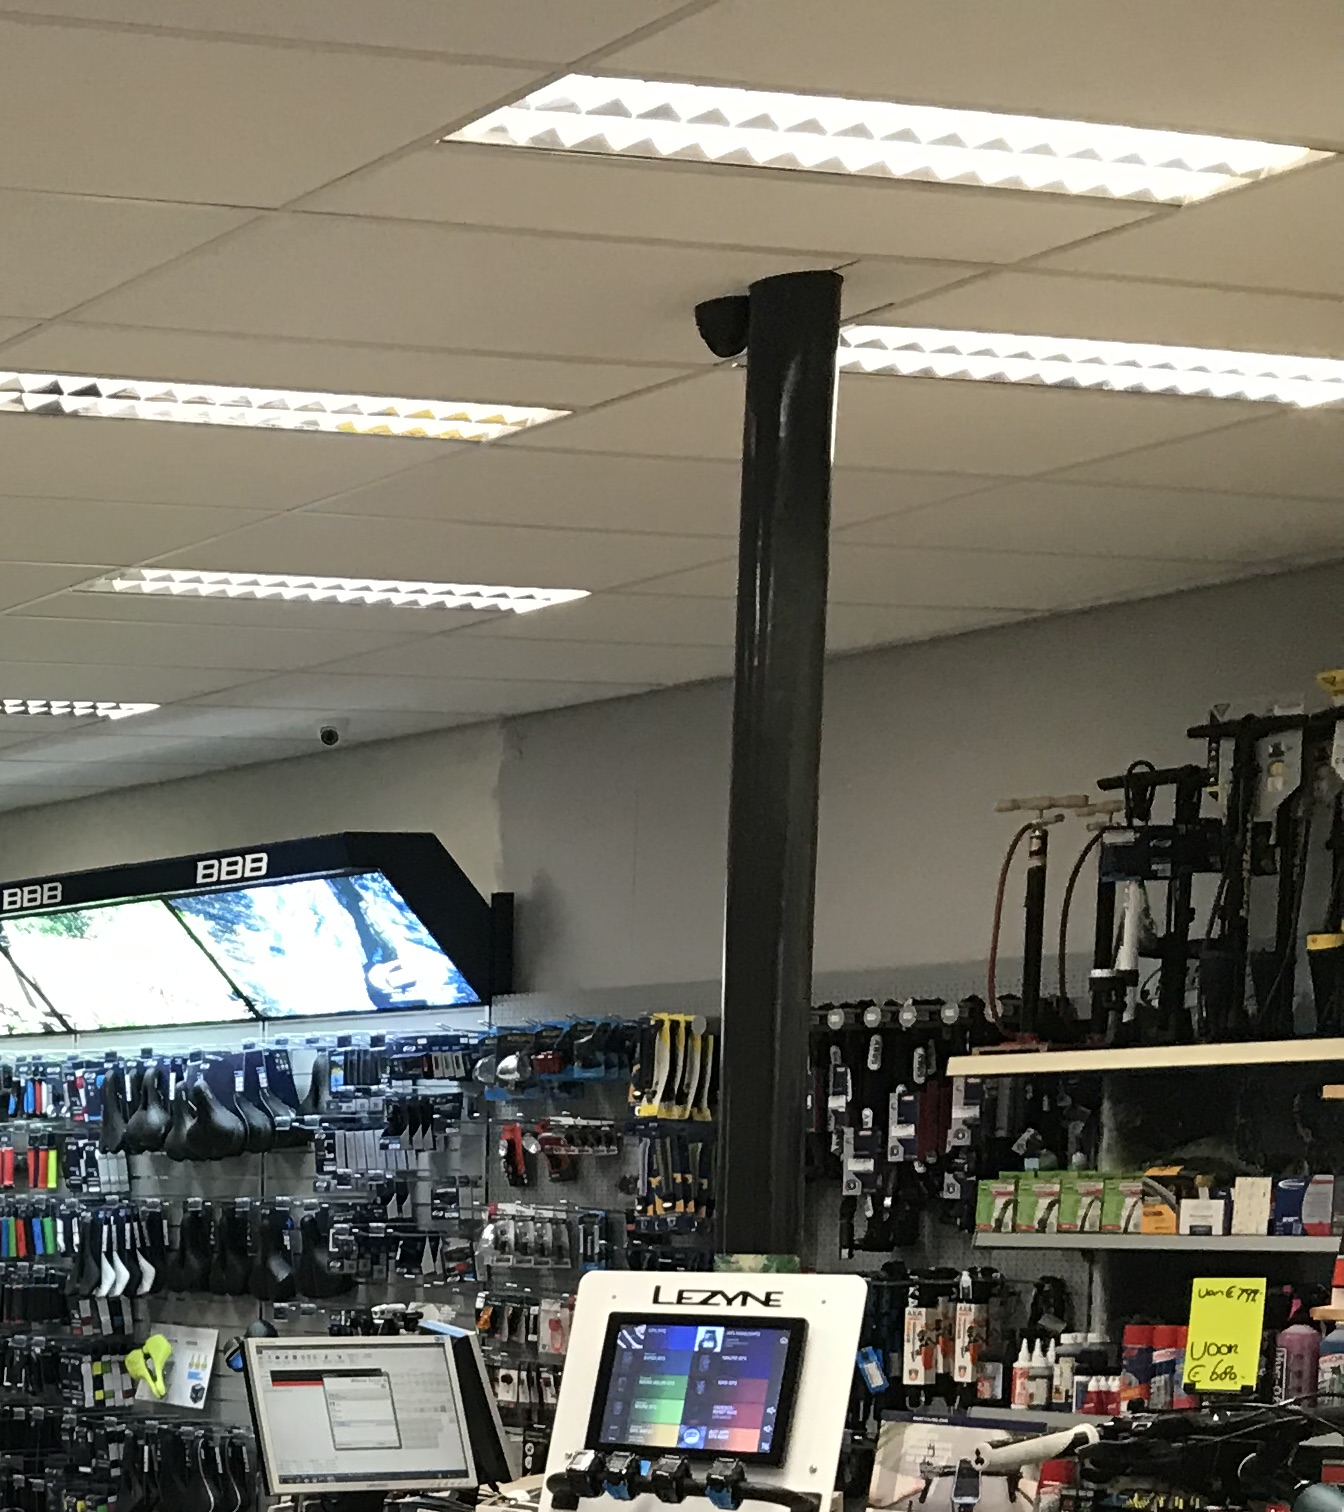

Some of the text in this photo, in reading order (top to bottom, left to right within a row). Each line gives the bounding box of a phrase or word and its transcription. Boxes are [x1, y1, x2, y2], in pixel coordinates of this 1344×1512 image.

[196, 852, 268, 884] BBB
[3, 882, 62, 910] BBB
[652, 1285, 784, 1307] LEZYNE
